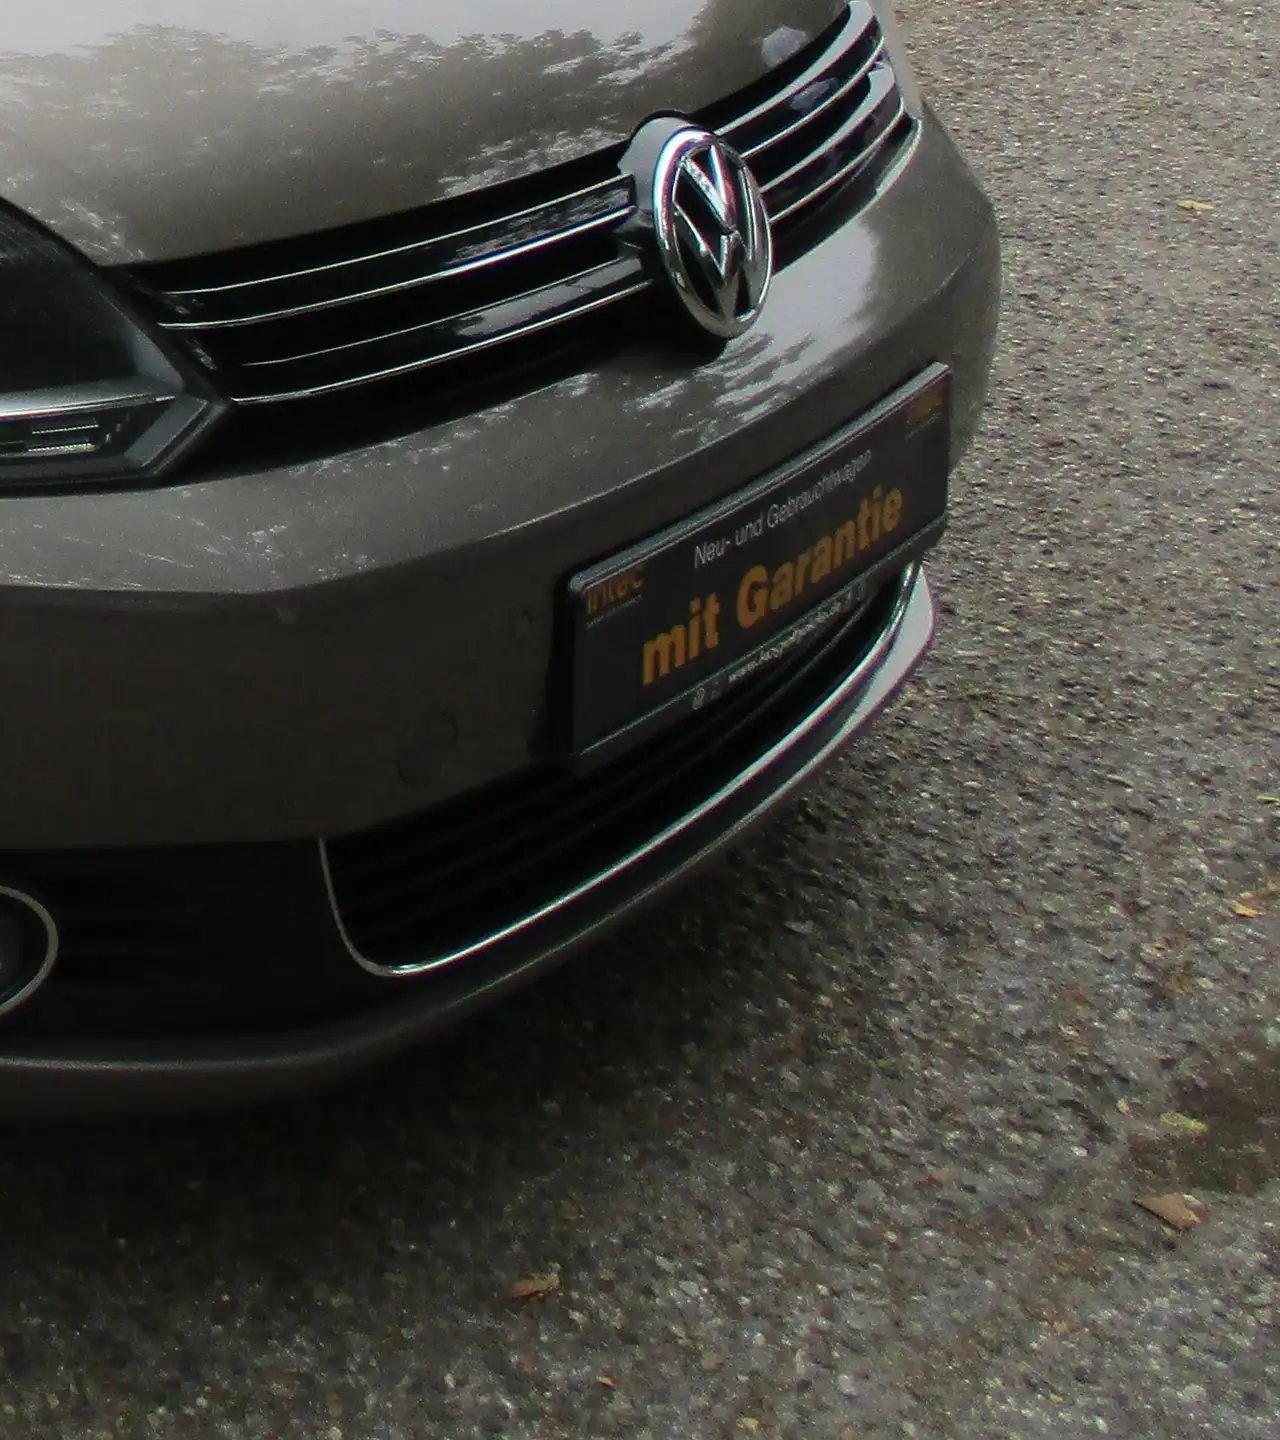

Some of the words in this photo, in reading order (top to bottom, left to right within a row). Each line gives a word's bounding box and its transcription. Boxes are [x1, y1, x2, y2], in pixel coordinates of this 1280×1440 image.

[643, 592, 721, 687] mit
[736, 484, 903, 629] Garantie
[694, 537, 731, 569] Neu-
[735, 511, 764, 546] und
